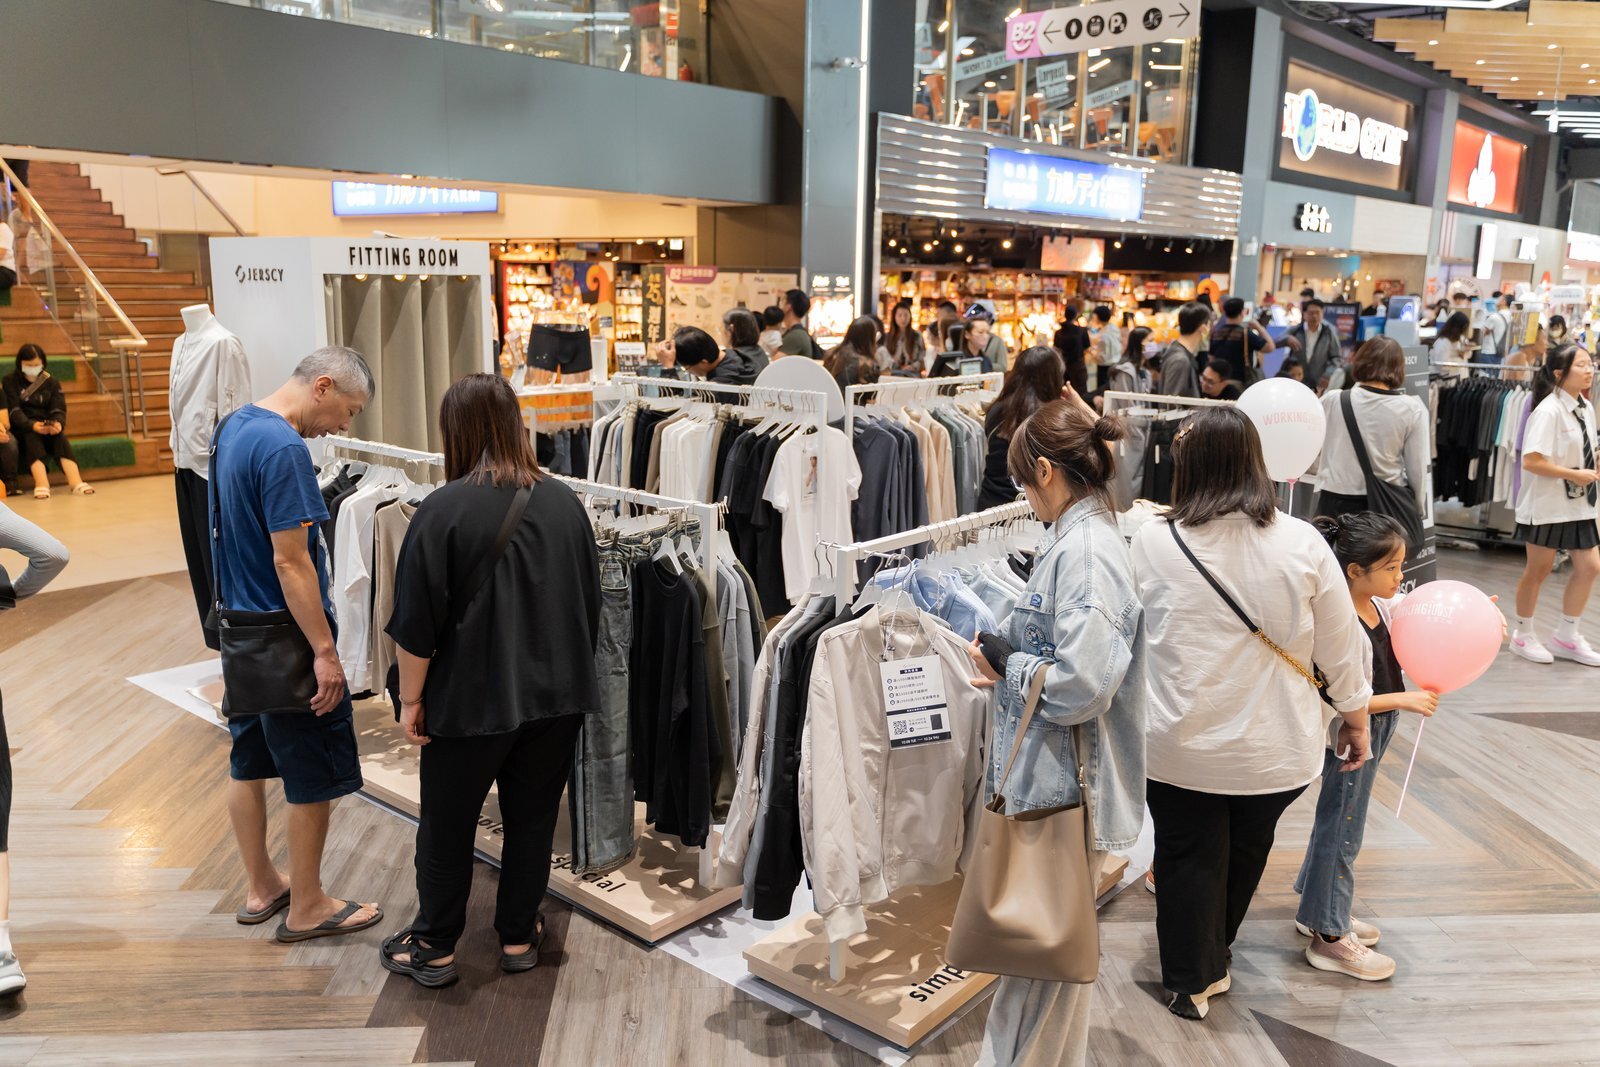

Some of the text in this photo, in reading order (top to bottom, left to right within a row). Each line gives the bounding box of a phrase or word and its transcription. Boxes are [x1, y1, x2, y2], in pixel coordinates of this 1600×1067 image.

[1010, 20, 1036, 42] B2
[349, 246, 459, 267] FITTING ROOM
[247, 268, 284, 282] JERSCY
[551, 856, 627, 893] spcial
[909, 963, 967, 1002] simp
